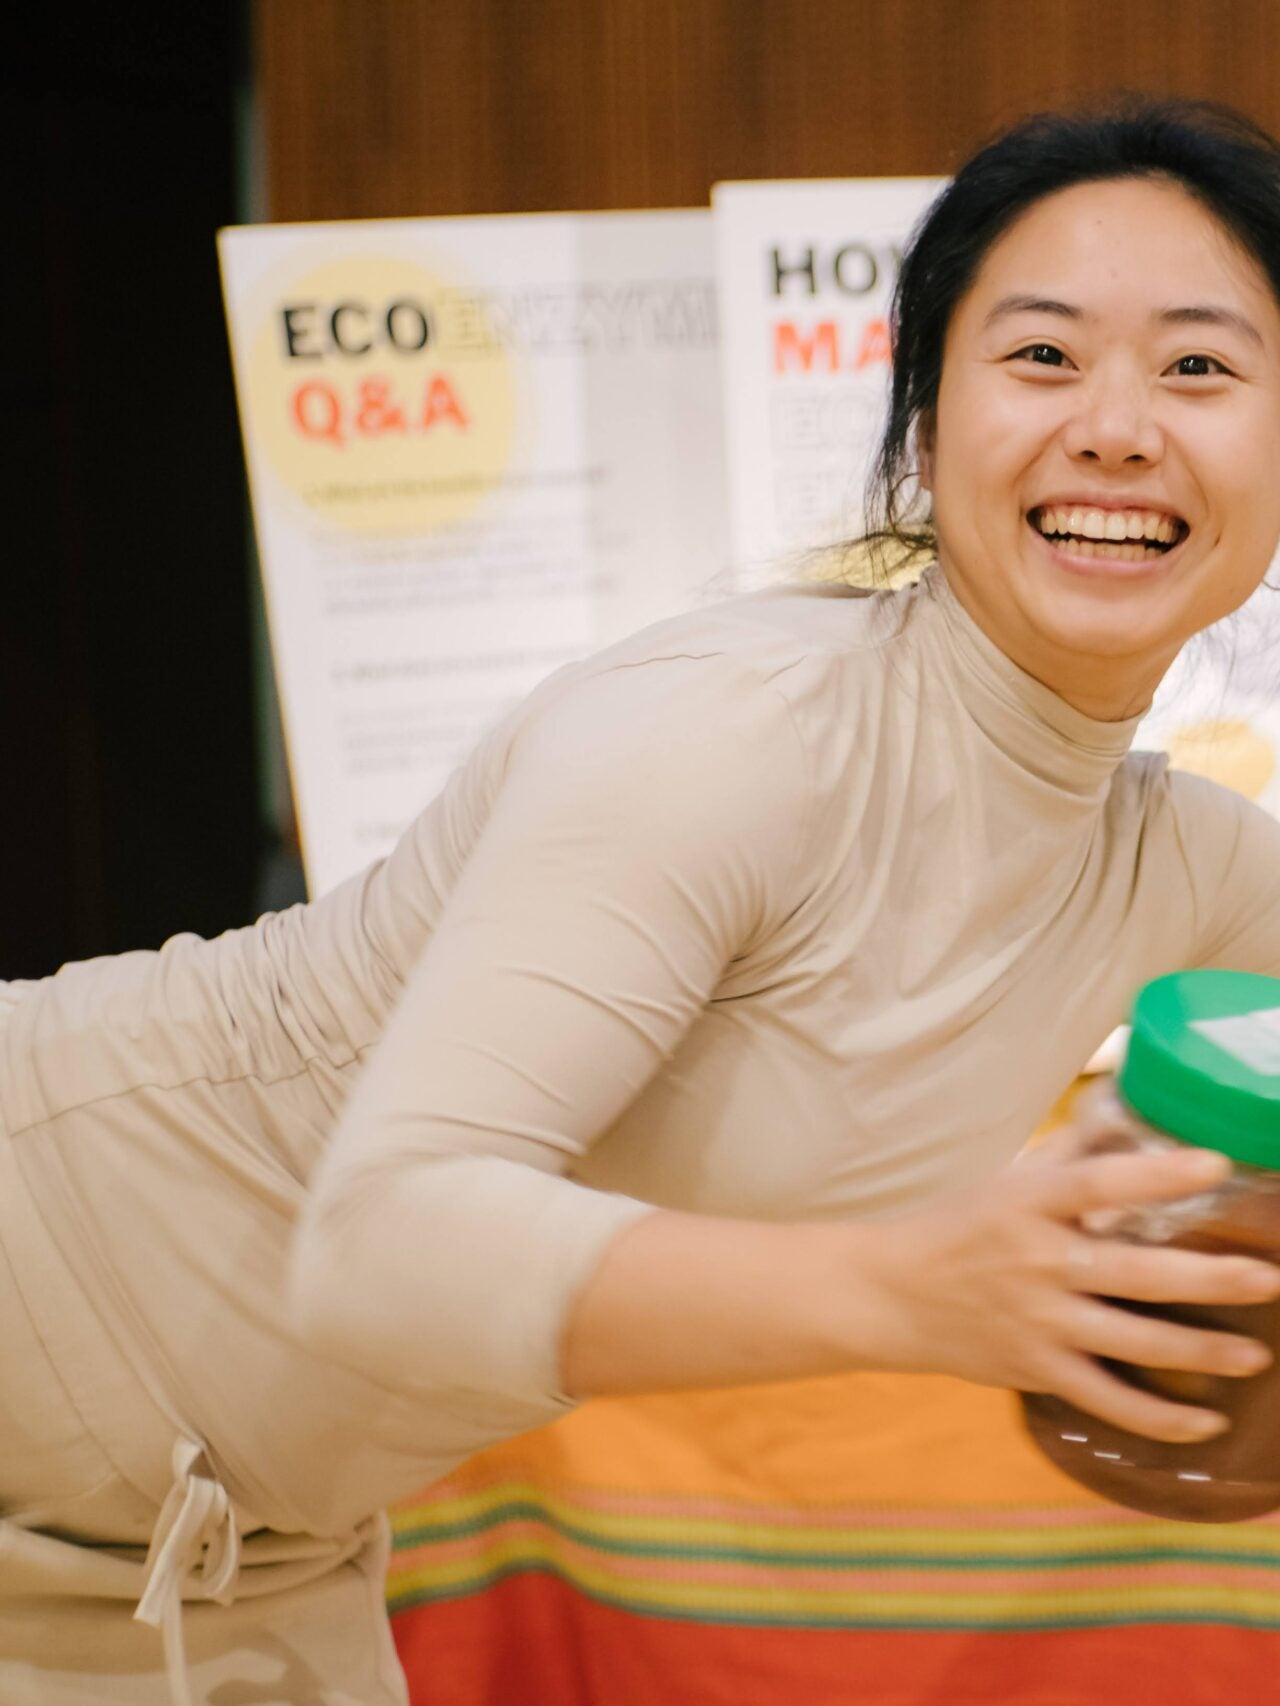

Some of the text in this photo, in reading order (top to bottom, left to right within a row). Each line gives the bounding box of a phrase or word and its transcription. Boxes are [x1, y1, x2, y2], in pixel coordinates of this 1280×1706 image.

[281, 299, 431, 360] ECO
[774, 319, 893, 374] MA
[291, 371, 471, 448] Q&A
